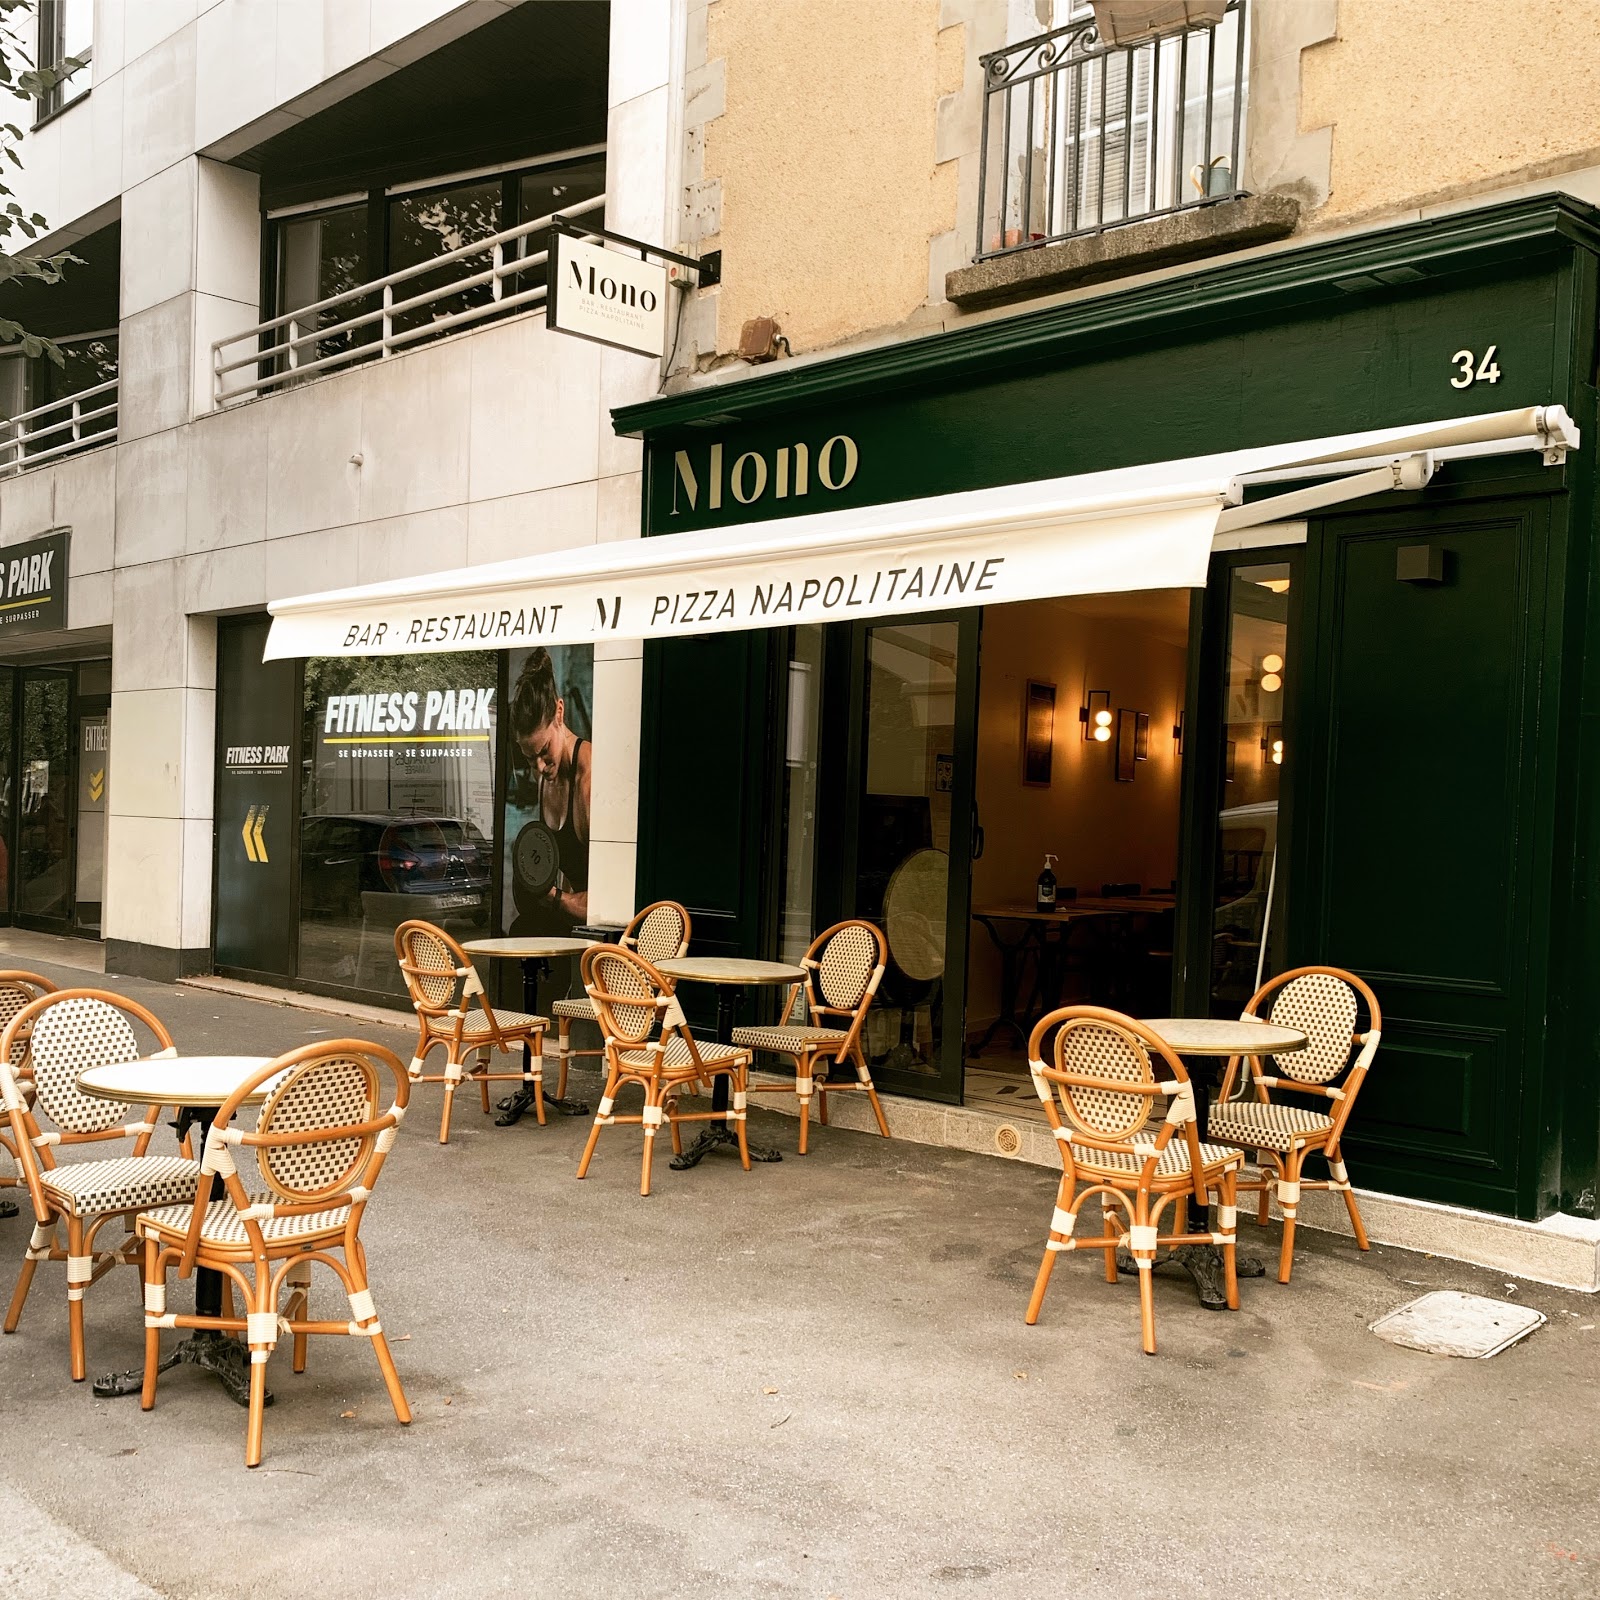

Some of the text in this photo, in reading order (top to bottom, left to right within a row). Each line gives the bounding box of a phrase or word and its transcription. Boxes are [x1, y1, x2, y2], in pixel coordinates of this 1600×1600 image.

[569, 260, 657, 312] Mono
[579, 305, 645, 329] PIZZA NAPOLITAINE
[601, 304, 642, 321] RESTAURANT
[1450, 345, 1500, 388] 34
[669, 435, 858, 515] Mono
[7, 550, 54, 598] PARK
[5, 610, 40, 623] SURPASSER
[342, 622, 388, 647] BAR
[405, 605, 563, 644] RESTAURANT
[650, 588, 735, 626] PIZZA
[749, 557, 1005, 616] NAPOLITAINE
[324, 688, 495, 733] FITNESS PARK
[226, 745, 290, 764] FITNESS PARK
[338, 747, 473, 758] SE DÉPASSER SE SURPASSER
